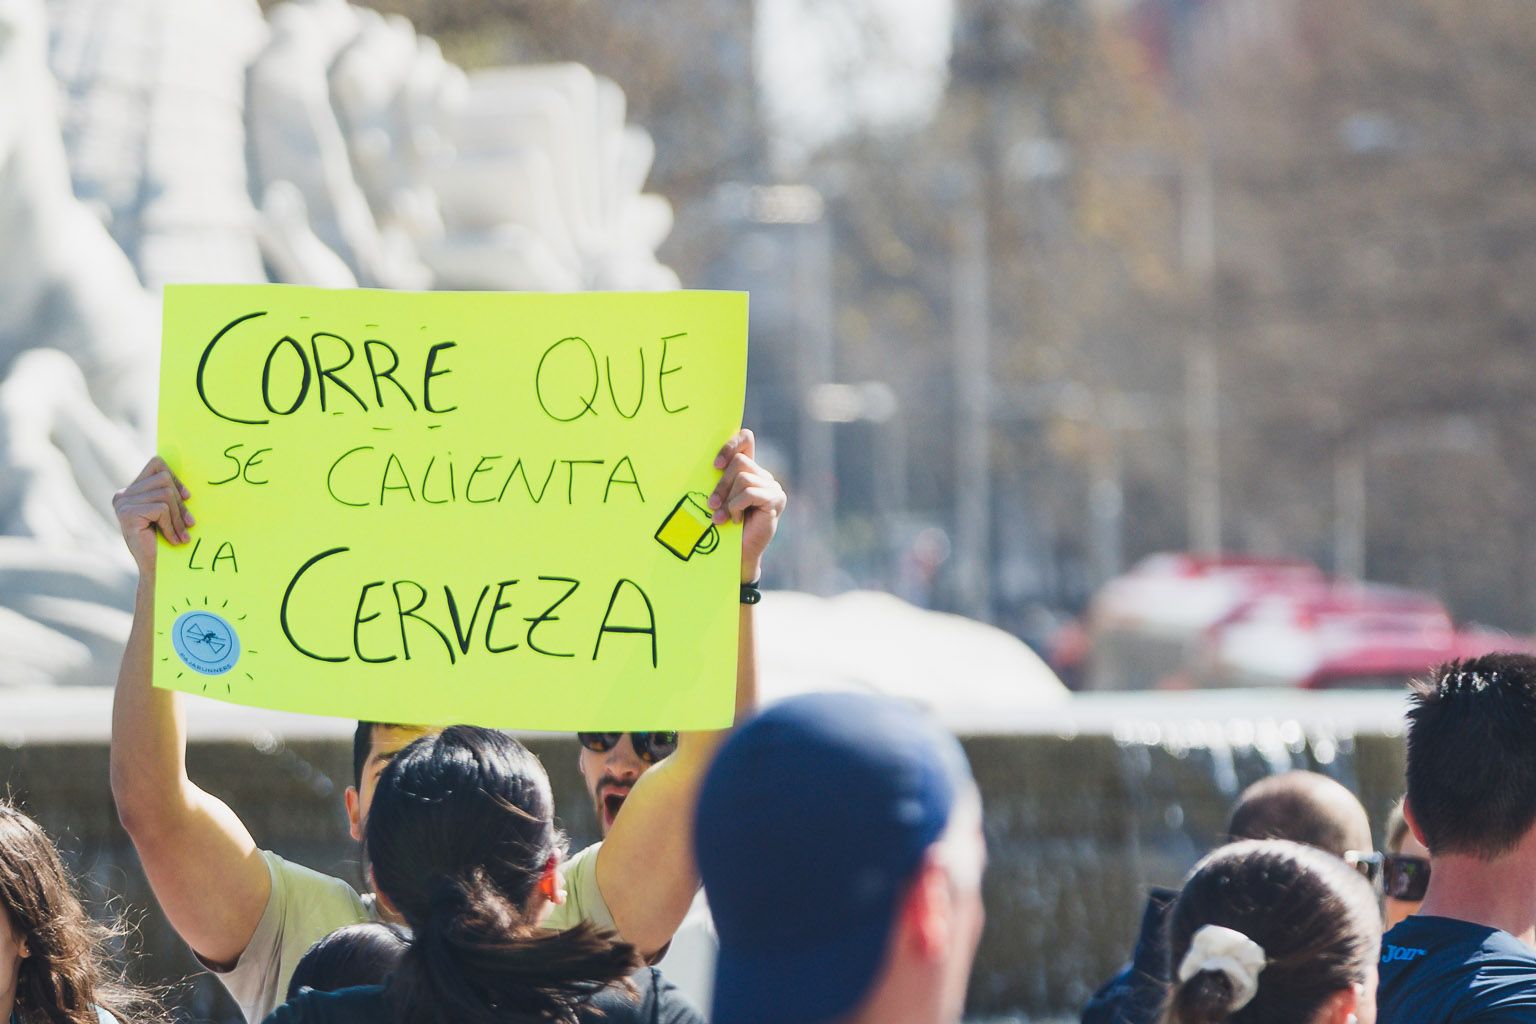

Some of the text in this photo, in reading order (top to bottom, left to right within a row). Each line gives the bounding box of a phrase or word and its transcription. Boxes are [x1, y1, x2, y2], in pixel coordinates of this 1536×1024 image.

[196, 312, 690, 424] CORRE QUE
[207, 444, 273, 485] SE
[187, 537, 658, 669] LA CERVEZA
